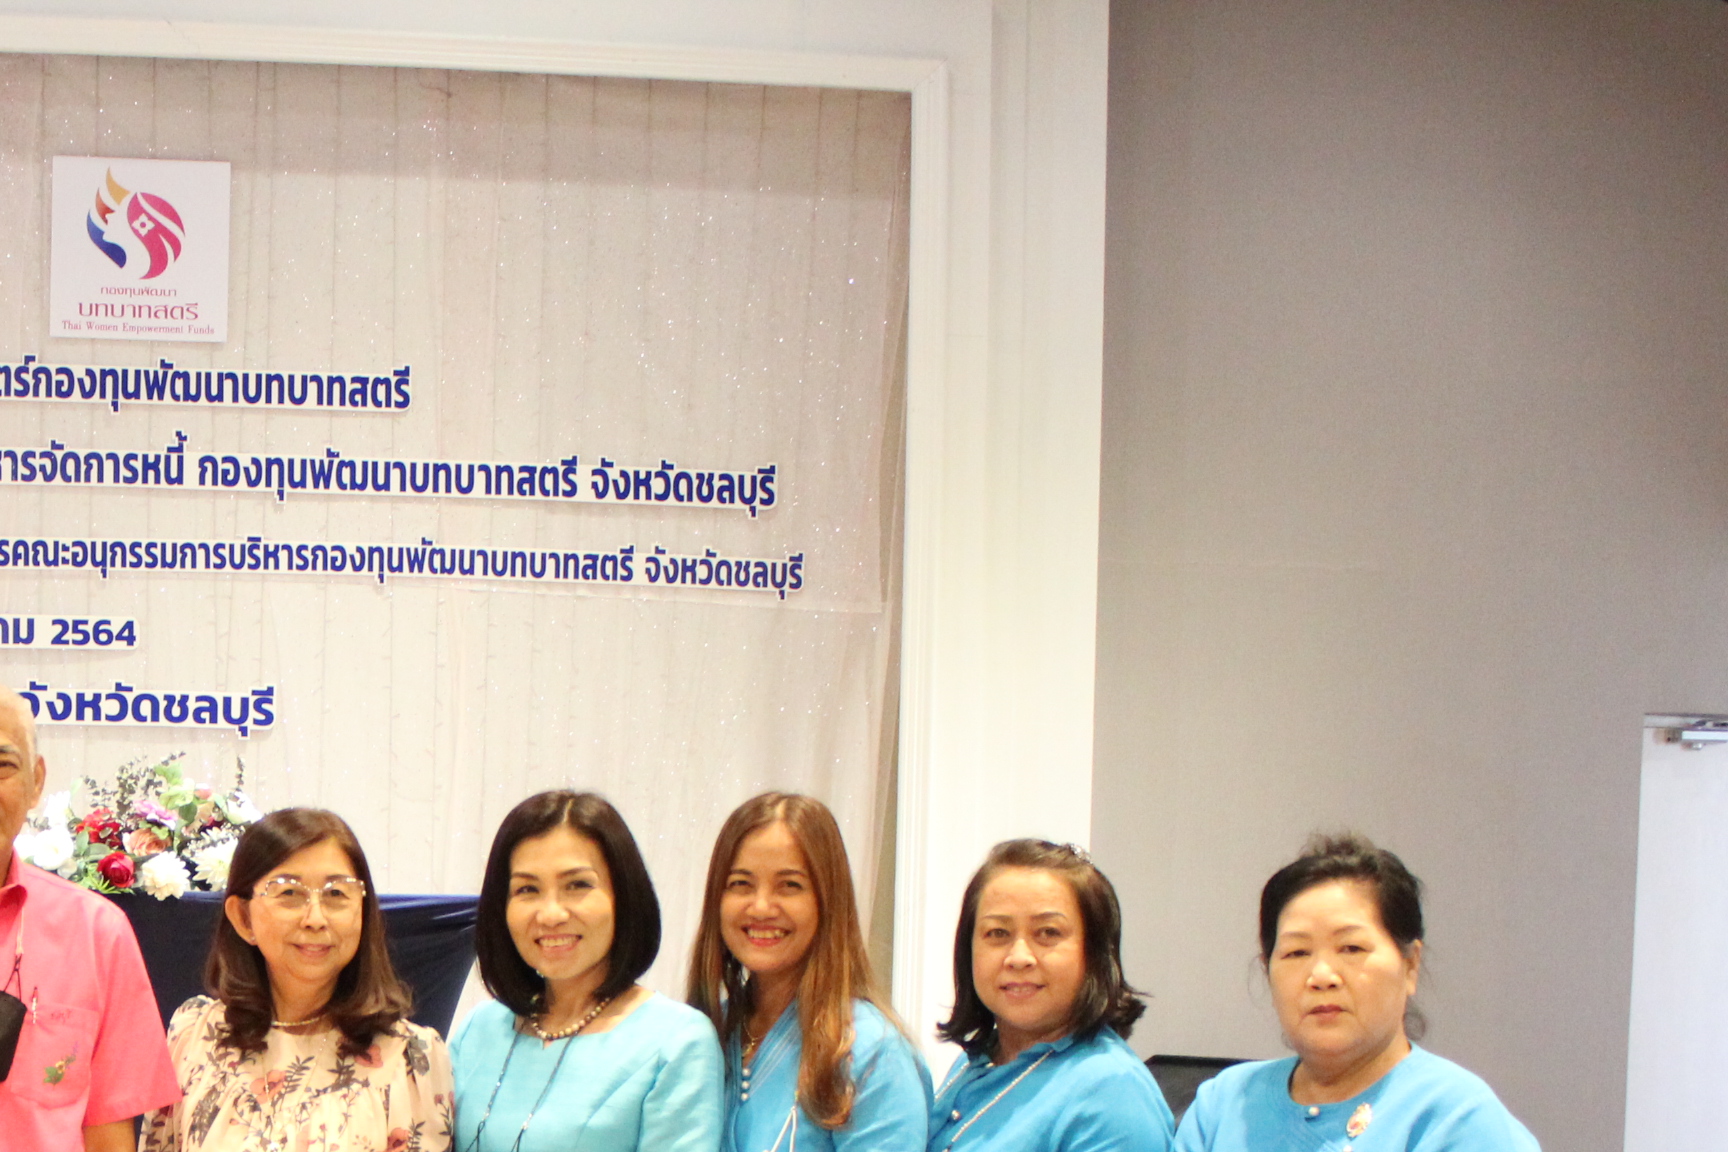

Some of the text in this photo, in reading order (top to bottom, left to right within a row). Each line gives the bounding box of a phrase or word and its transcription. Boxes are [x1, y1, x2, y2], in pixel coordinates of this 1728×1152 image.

[100, 286, 177, 298] กองทุนพัฒนา
[78, 302, 199, 321] บทบาทสตรี
[62, 320, 215, 335] Thai Women Empowerment Funds
[198, 448, 578, 500] กองทุนพัฒนาบทบาทสตรี
[592, 457, 776, 517] จังหวัดชลบุรี
[646, 546, 803, 599] จังหวัดชลบุรี
[51, 619, 136, 646] 2564
